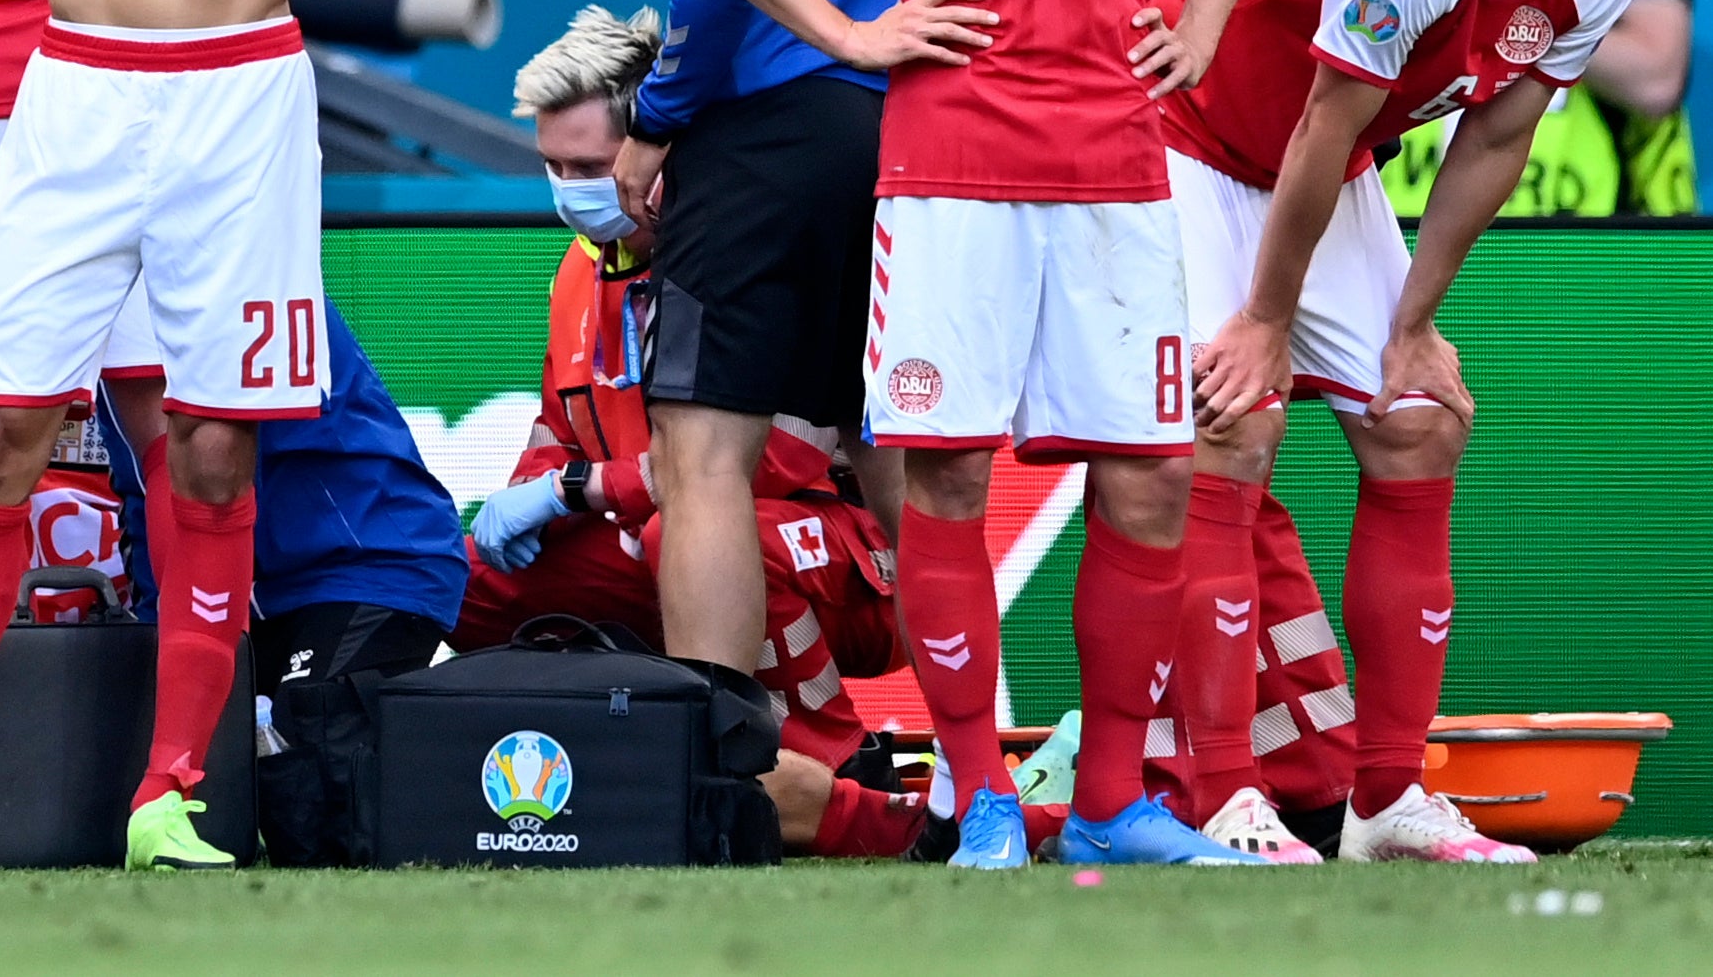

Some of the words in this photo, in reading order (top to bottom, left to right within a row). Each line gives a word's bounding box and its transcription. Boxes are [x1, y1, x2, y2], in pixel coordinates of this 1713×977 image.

[1506, 25, 1540, 42] DBU
[1408, 75, 1478, 120] 6
[242, 298, 315, 388] 20
[899, 376, 932, 394] DBU
[1154, 335, 1183, 424] 8
[509, 817, 542, 832] UEFA
[477, 833, 578, 852] EURO2020
